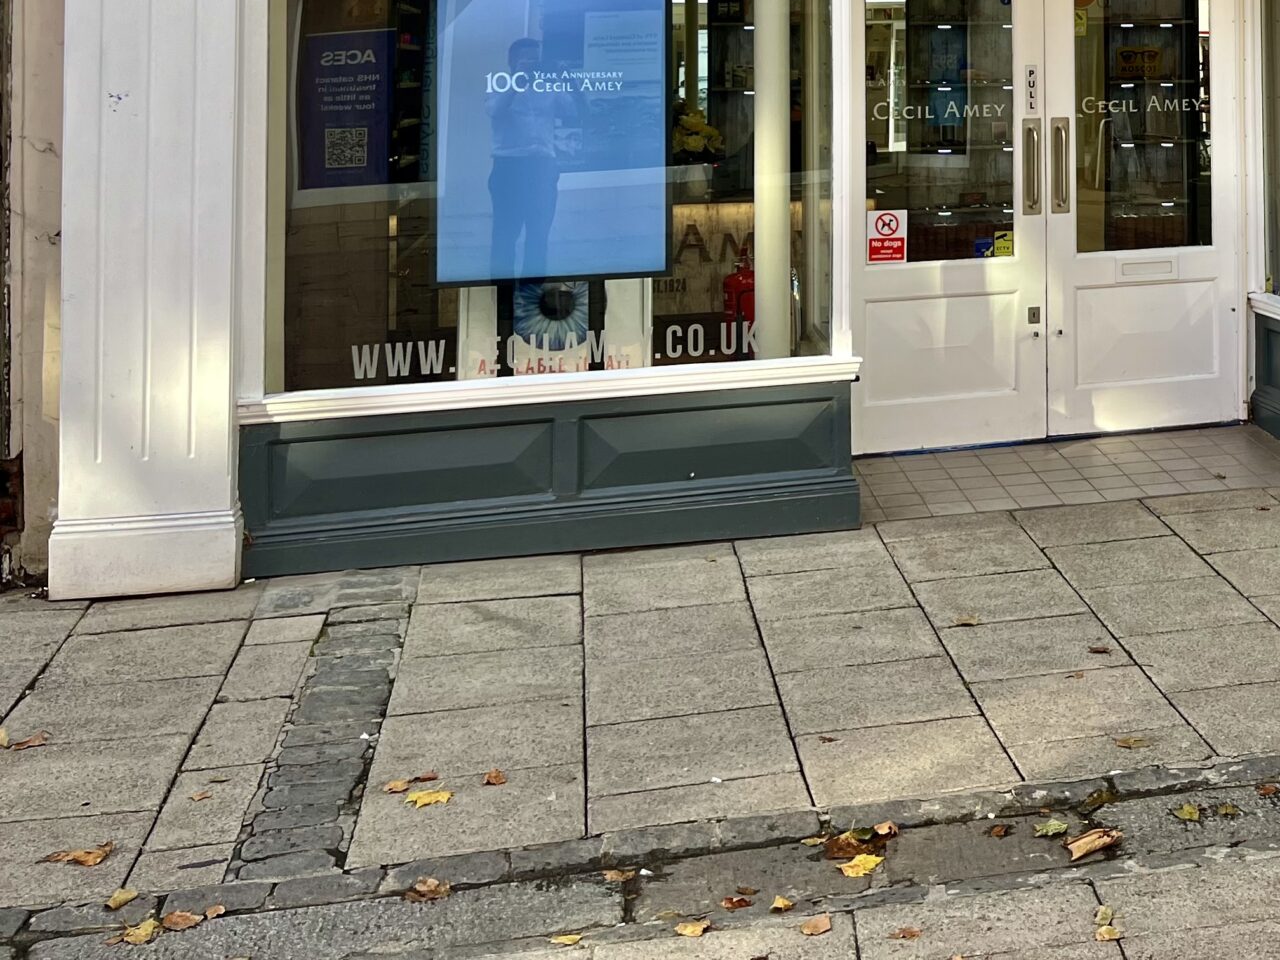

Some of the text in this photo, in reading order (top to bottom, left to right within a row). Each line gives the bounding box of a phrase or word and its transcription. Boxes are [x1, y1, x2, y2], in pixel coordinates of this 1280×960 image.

[532, 78, 624, 93] CECIL AMEY
[1027, 68, 1036, 112] PULL
[872, 100, 1007, 121] CECIL AMEY
[1081, 94, 1203, 114] CECIL AMEY
[871, 239, 902, 248] No dogs
